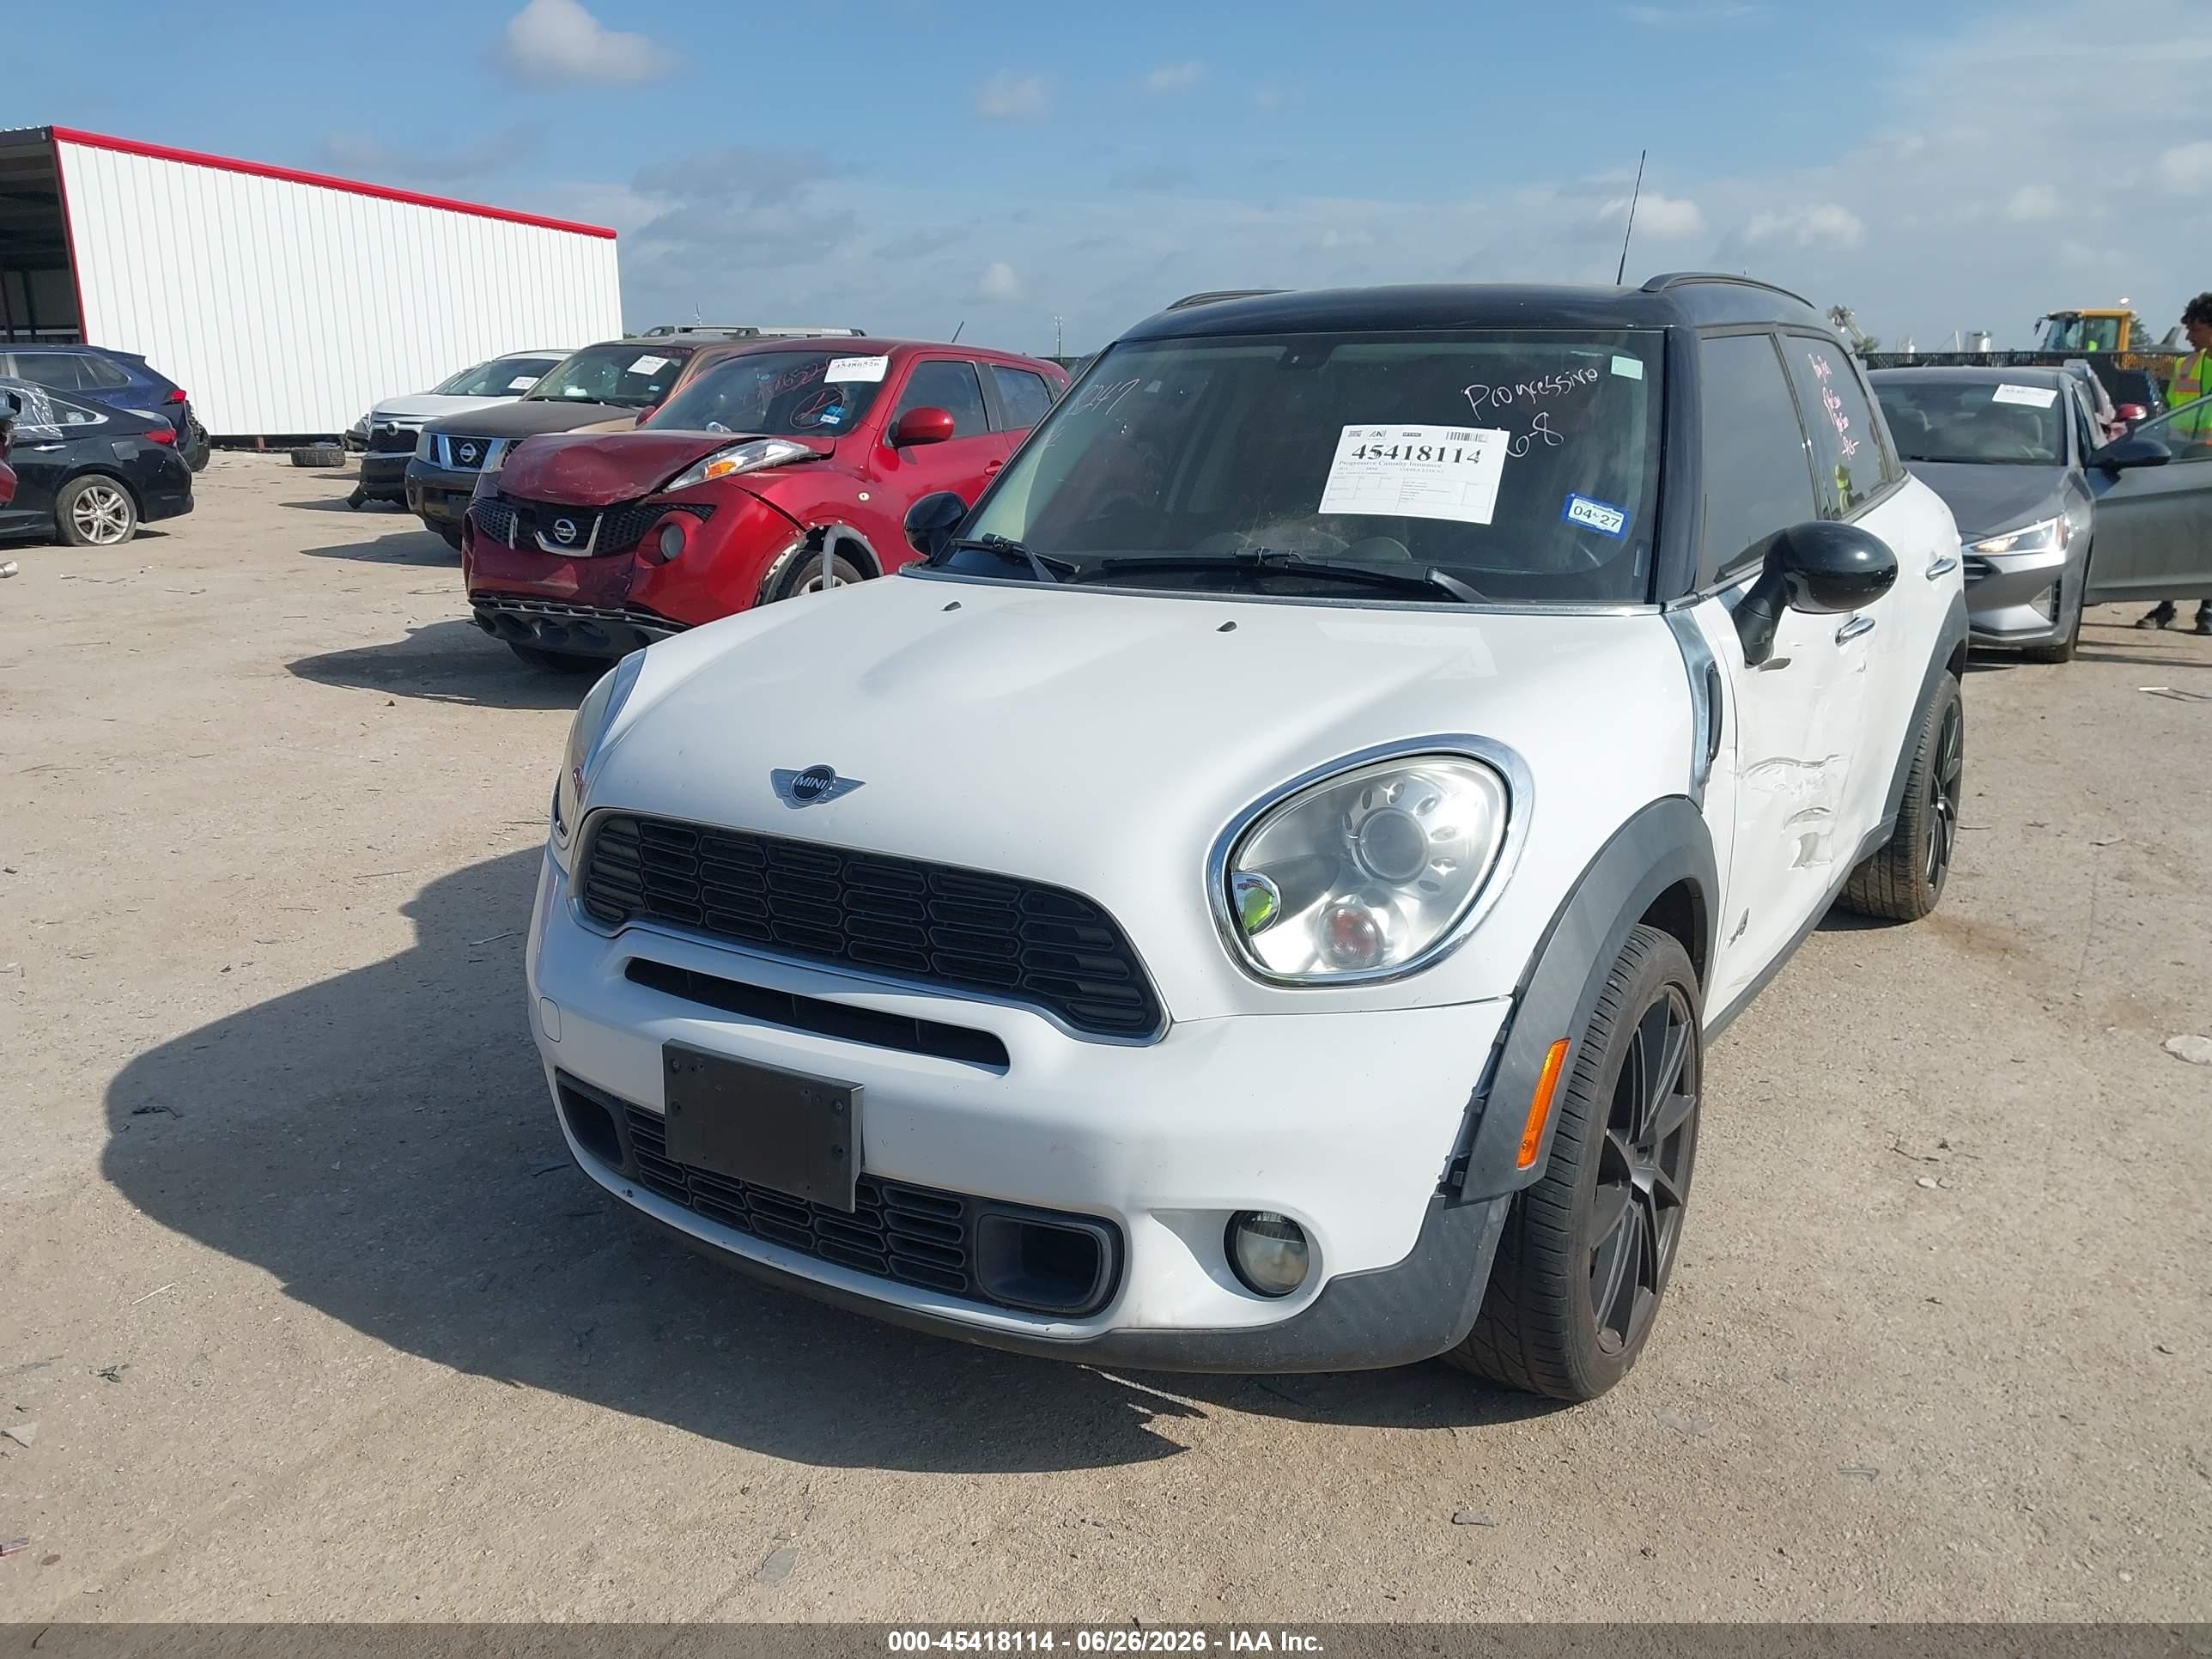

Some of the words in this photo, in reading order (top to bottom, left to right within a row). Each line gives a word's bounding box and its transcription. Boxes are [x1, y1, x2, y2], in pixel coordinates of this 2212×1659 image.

[1351, 443, 1482, 465] 45418114
[1573, 505, 1592, 520] 04
[1599, 514, 1620, 528] 27
[796, 776, 828, 789] MINI
